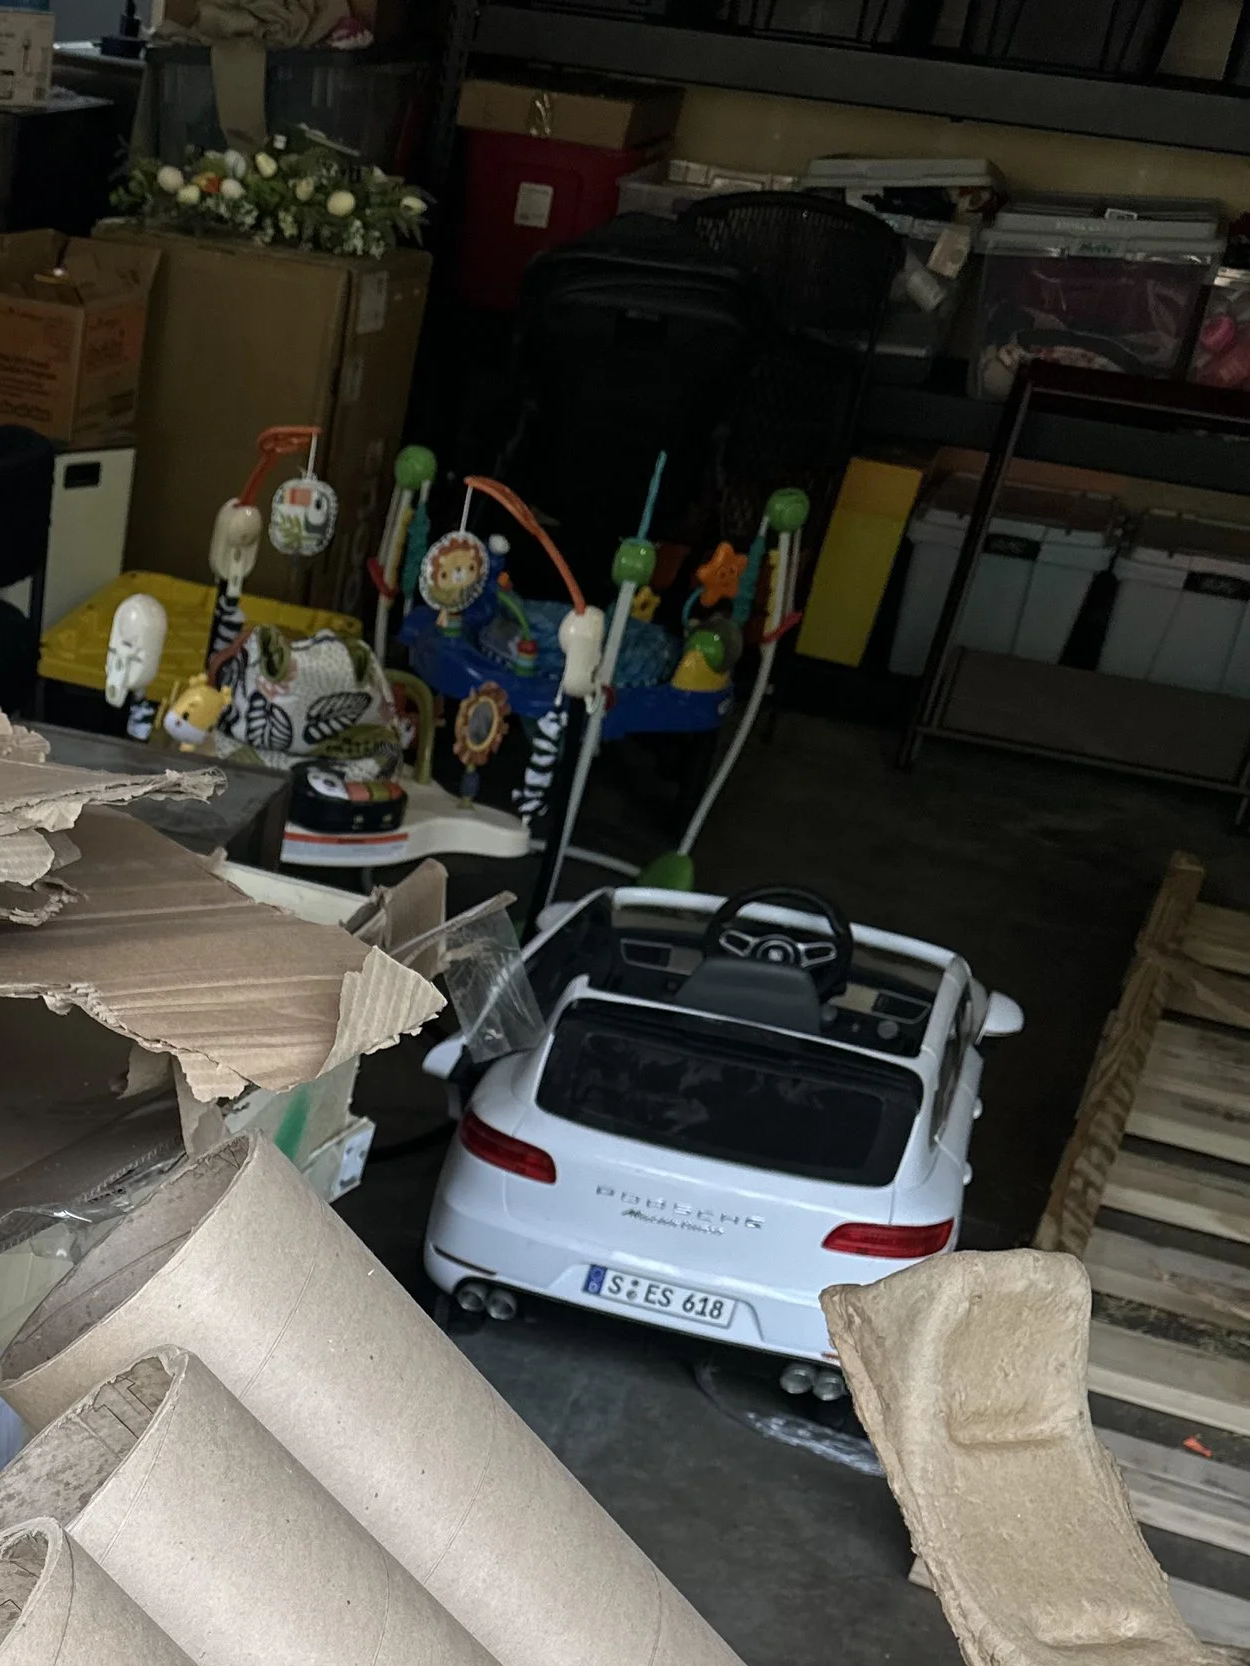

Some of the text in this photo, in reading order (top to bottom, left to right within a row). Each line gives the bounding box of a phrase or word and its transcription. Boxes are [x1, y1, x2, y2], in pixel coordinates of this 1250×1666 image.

[595, 1184, 766, 1230] PORSCHE
[607, 1275, 724, 1320] S ES 618
